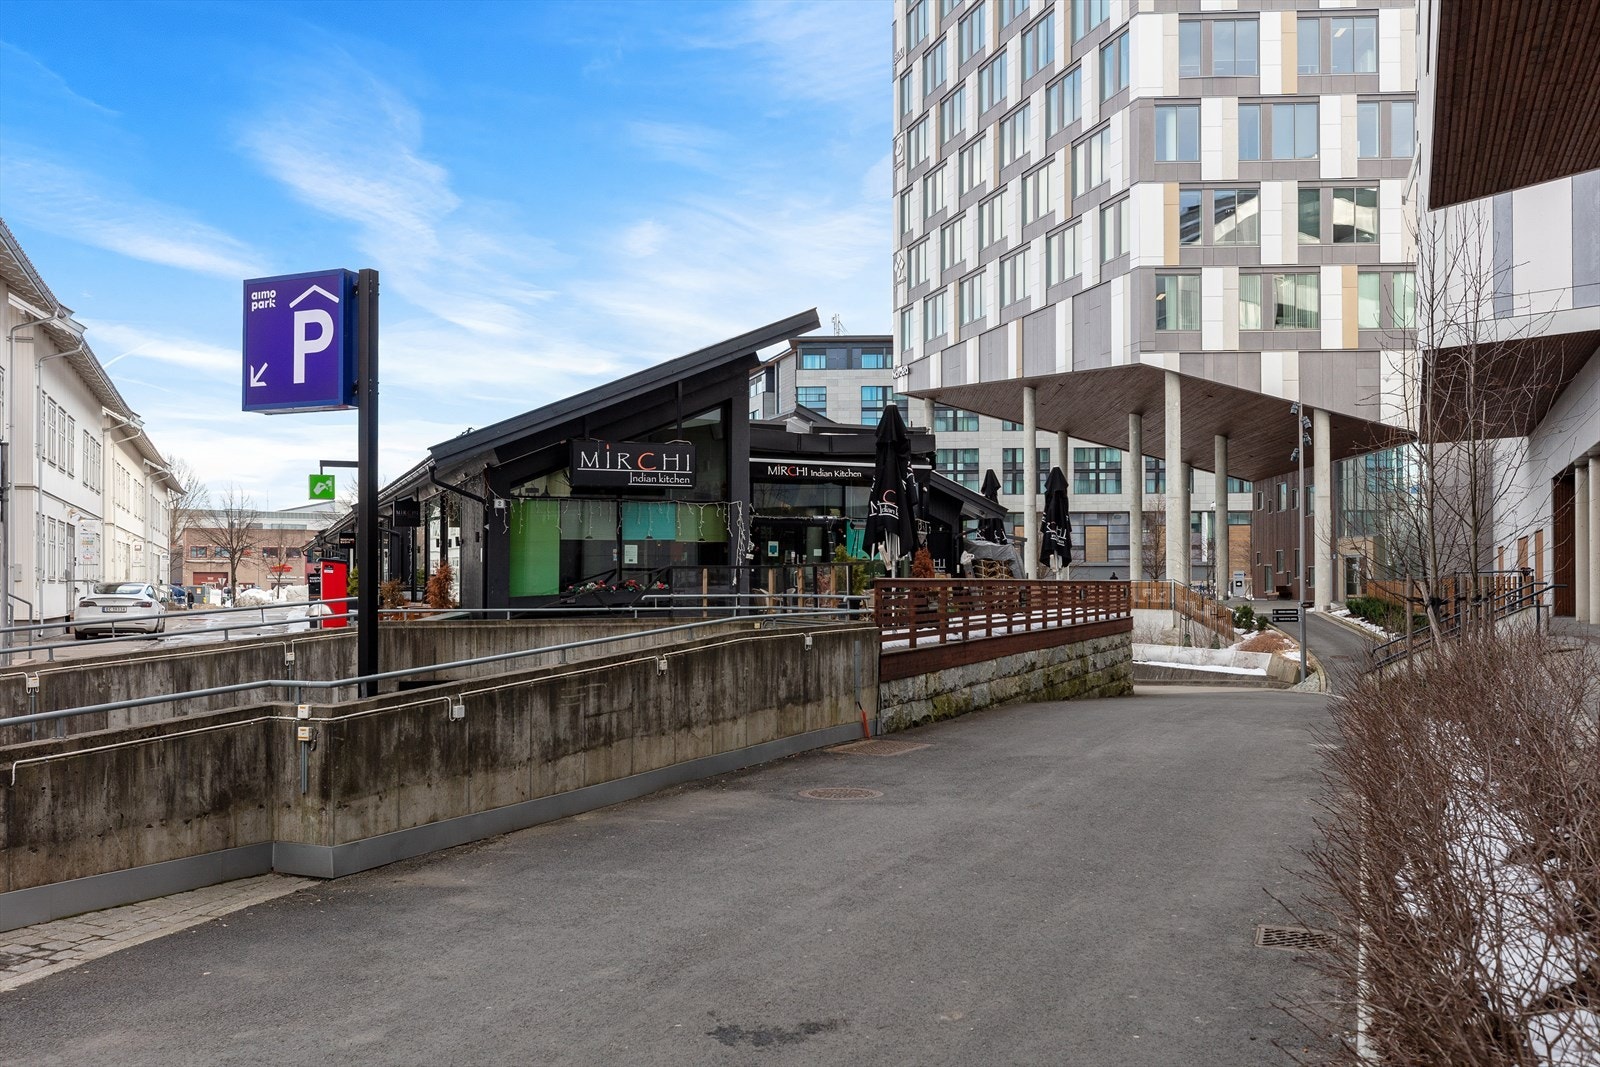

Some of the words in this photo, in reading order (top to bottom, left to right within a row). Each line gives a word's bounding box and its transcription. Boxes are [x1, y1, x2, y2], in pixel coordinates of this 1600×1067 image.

[251, 290, 277, 300] aimo
[251, 299, 277, 312] park
[293, 309, 334, 384] P
[629, 472, 657, 484] Indian
[658, 472, 691, 484] kitchen
[810, 468, 833, 477] Indian
[834, 468, 862, 478] Kitchen
